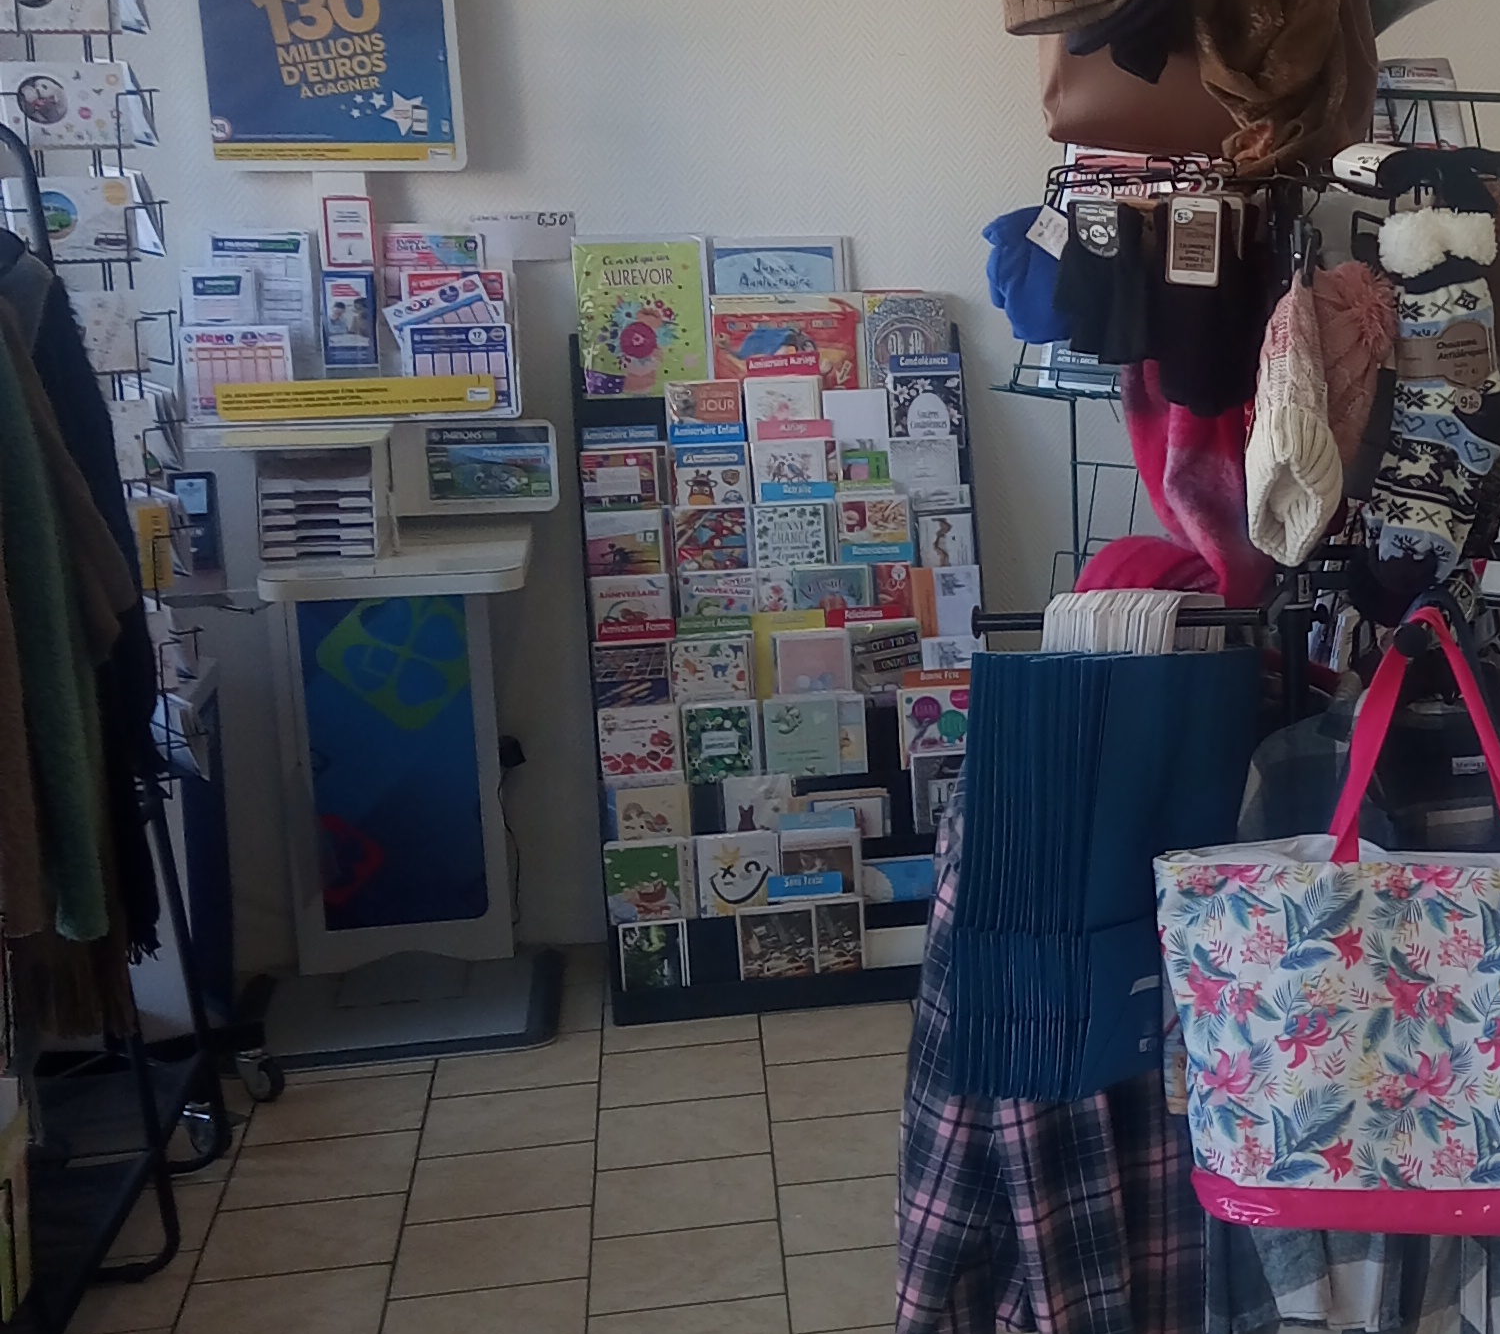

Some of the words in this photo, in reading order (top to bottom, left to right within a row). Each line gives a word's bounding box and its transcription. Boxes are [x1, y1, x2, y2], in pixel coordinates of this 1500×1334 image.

[276, 33, 386, 66] MILLIONS
[281, 52, 388, 87] D'EUROS
[314, 76, 381, 97] GAGNER
[748, 356, 789, 369] Anniversaire
[790, 354, 817, 367] Mariage
[899, 355, 949, 367] Condoléances
[700, 399, 735, 412] JOUR
[674, 426, 716, 437] Anniversaire
[717, 424, 740, 435] Enfant
[771, 531, 809, 545] CHANCE
[694, 585, 752, 595] ANNIVERSAIRE
[600, 624, 645, 636] Anniversaire
